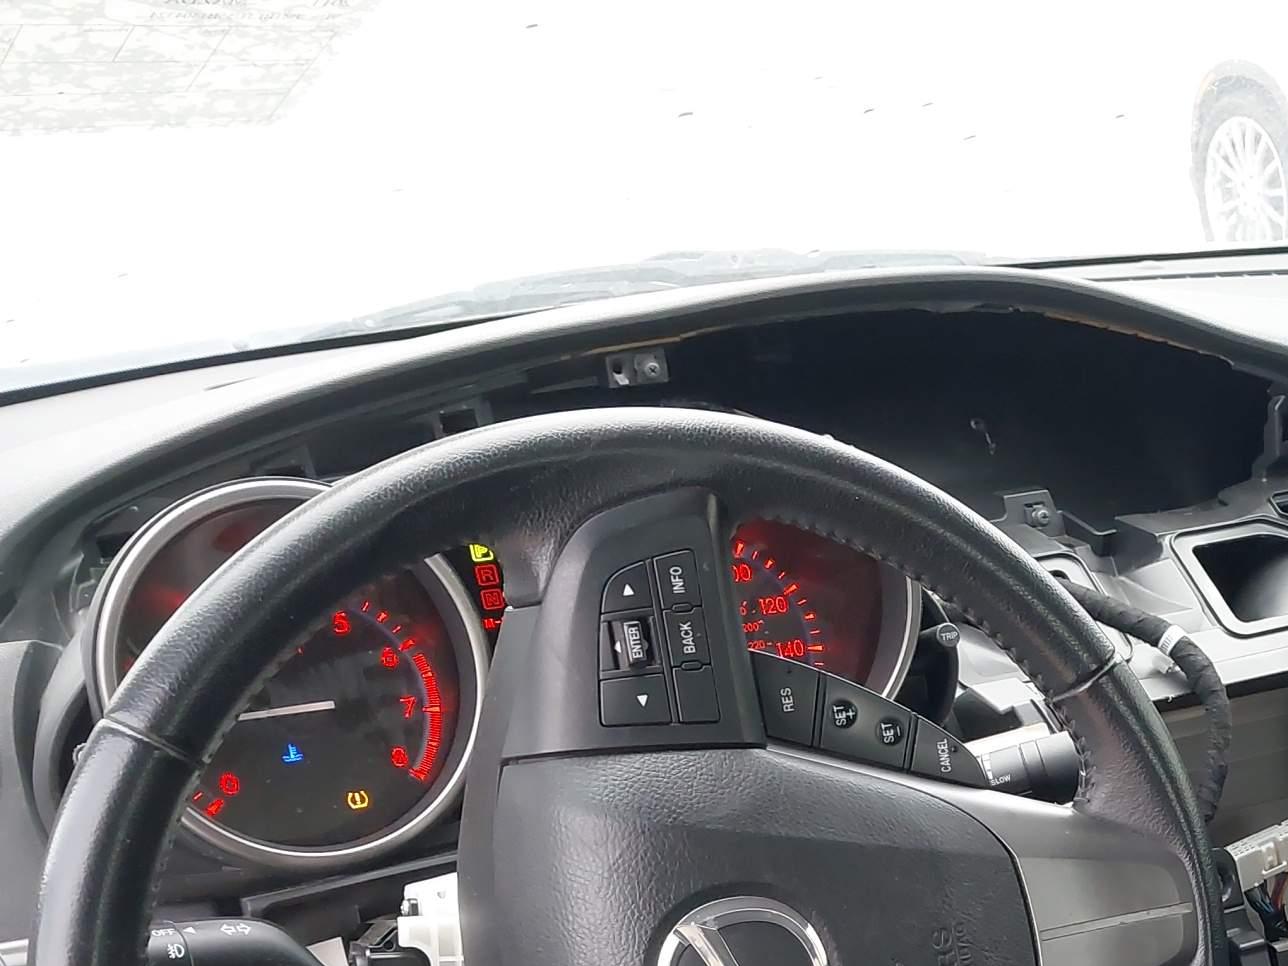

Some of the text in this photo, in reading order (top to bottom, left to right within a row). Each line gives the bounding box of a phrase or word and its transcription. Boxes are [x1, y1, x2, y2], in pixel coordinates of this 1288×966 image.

[669, 566, 685, 593] INFO
[759, 596, 788, 615] 120
[333, 611, 350, 634] 5
[628, 626, 644, 659] ENTER
[680, 621, 696, 654] BACK
[940, 631, 958, 641] TRIP
[776, 639, 805, 658] 140
[400, 696, 417, 719] 7
[780, 688, 795, 713] RES
[832, 704, 847, 727] SET
[879, 722, 895, 744] SET
[935, 738, 952, 774] CANCEL
[989, 774, 1011, 787] SLOW
[151, 928, 176, 936] OFF
